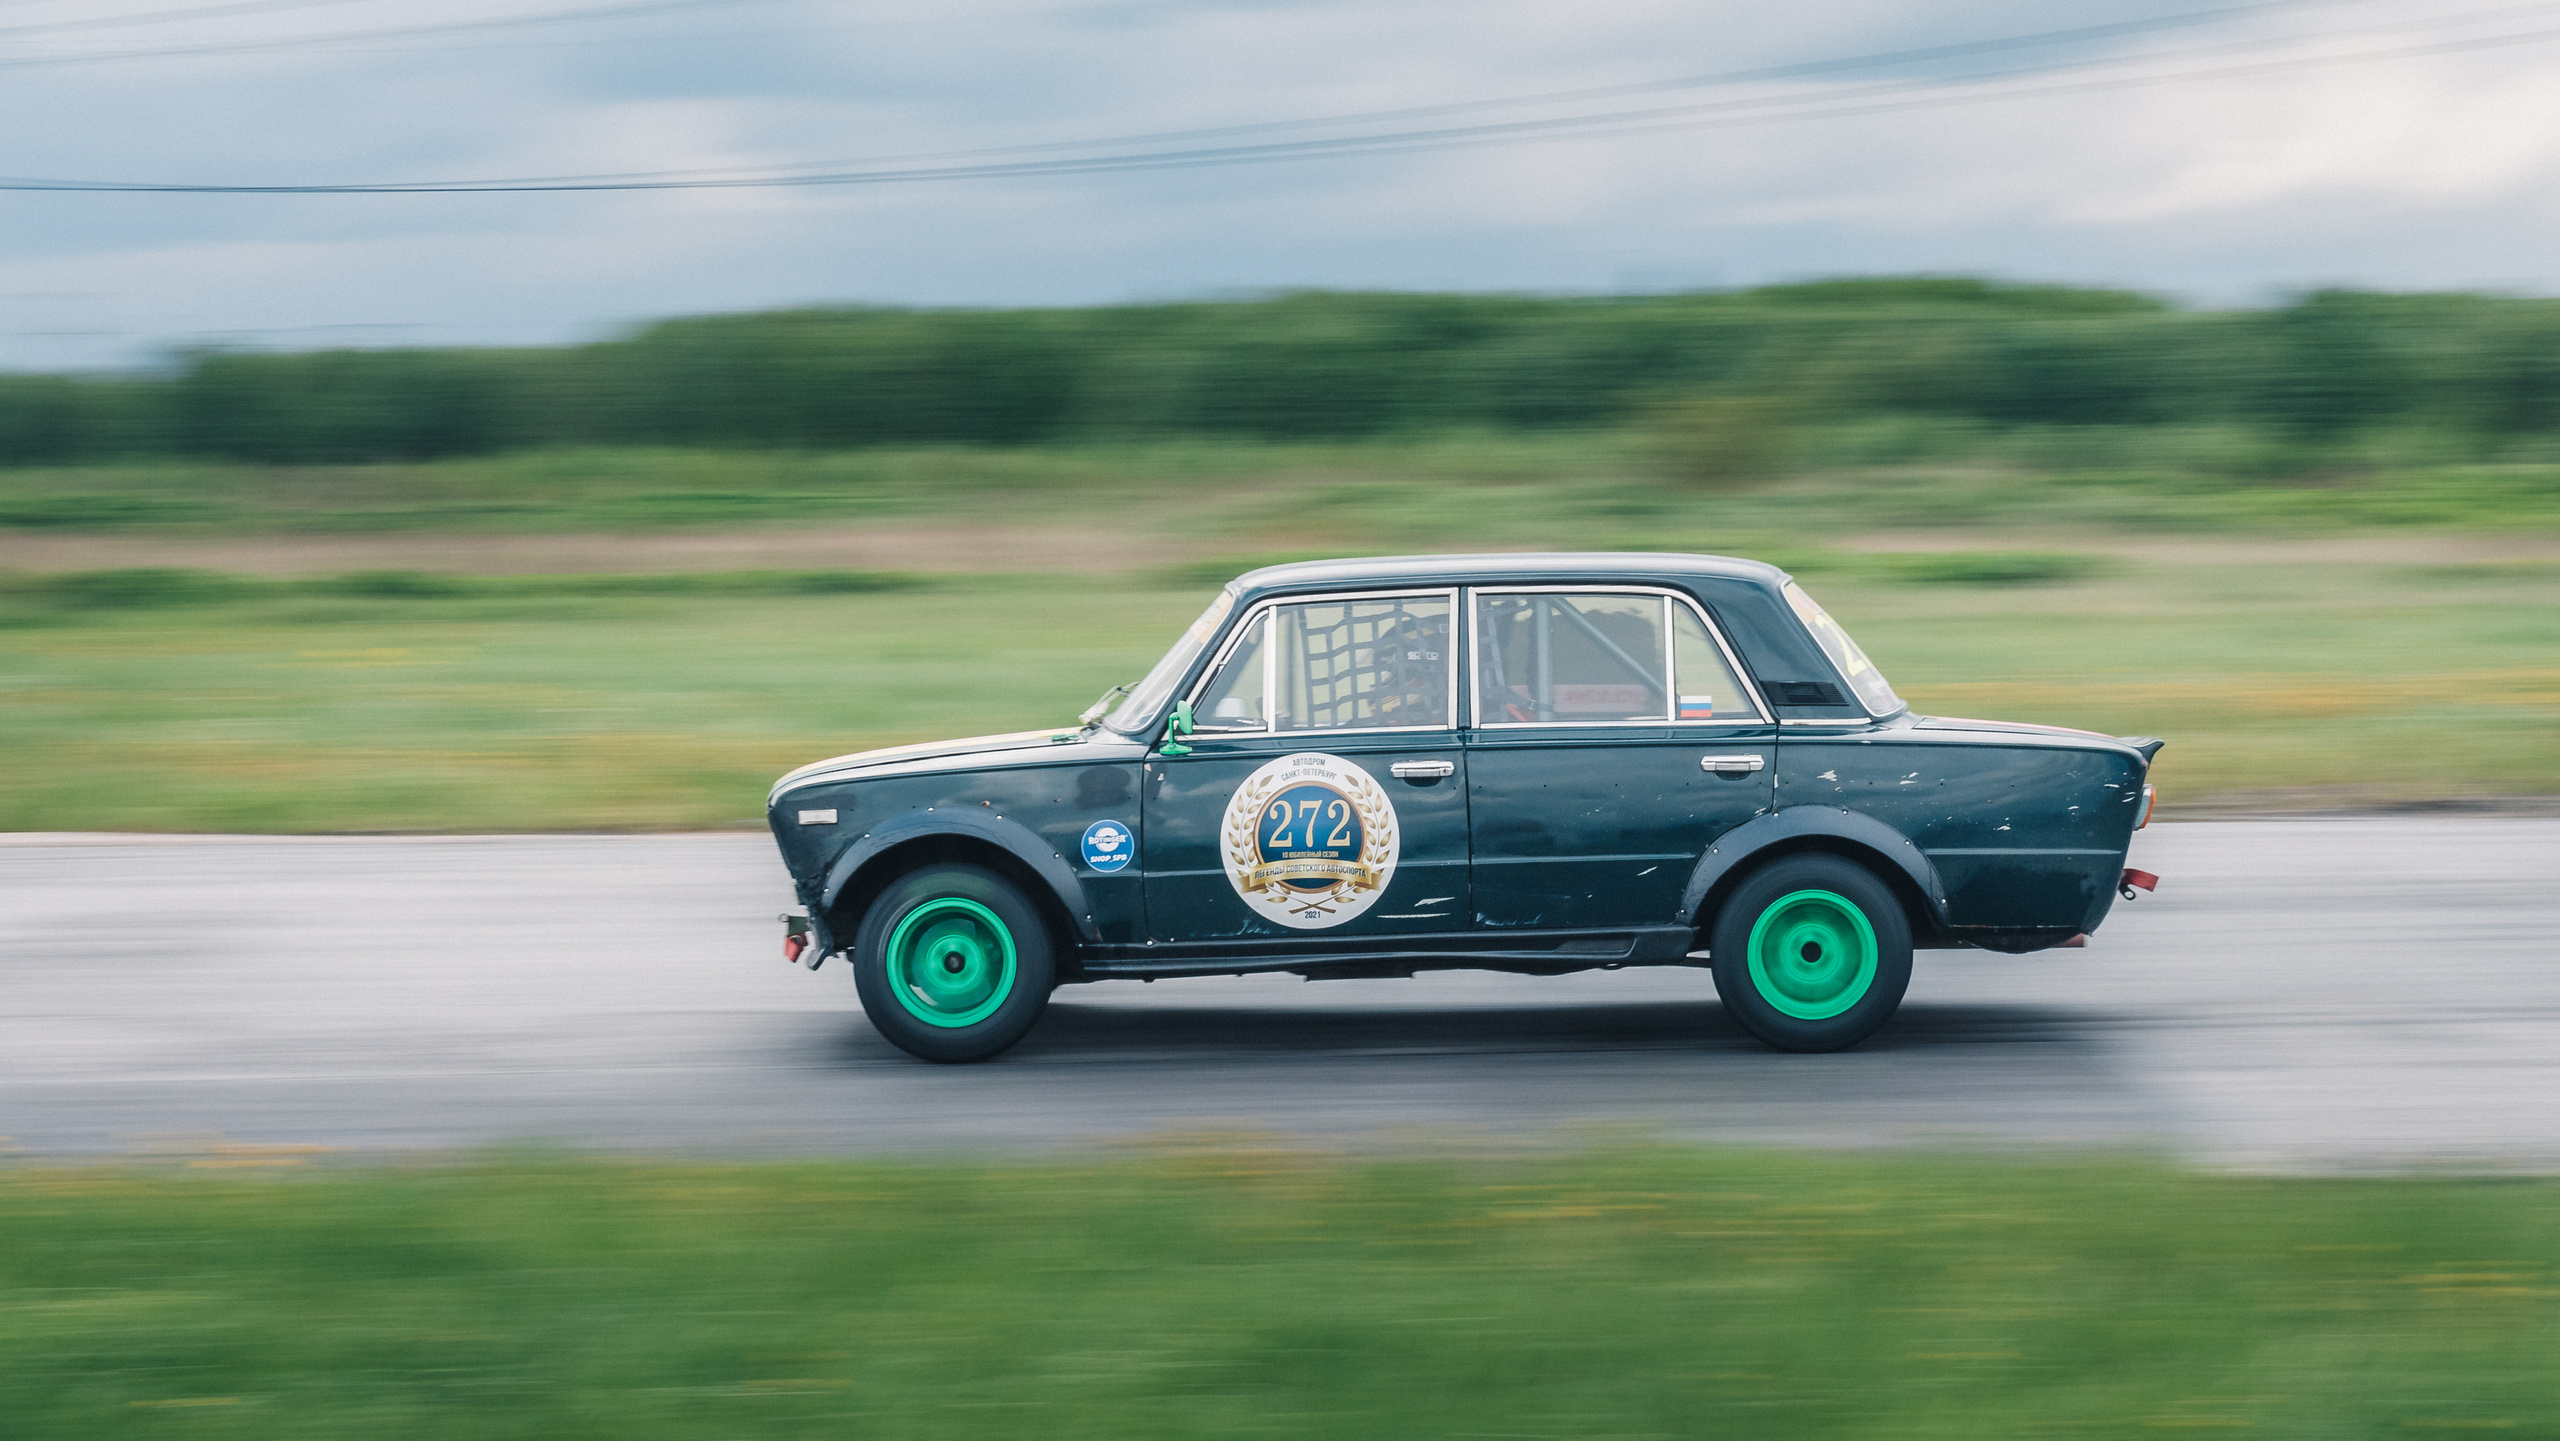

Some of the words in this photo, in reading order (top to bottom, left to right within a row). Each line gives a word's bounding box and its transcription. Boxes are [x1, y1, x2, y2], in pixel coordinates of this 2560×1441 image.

[1292, 758, 1326, 766] АВТОДРОМ
[1281, 769, 1337, 781] САНКТ-ПЕТЕРБУРГ
[1268, 799, 1351, 848] 272
[1289, 850, 1322, 858] ЮБИЛЕЙНЫЙ
[1255, 867, 1286, 879] ЛЕГЕНДЫ
[1286, 864, 1326, 874] СОВЕТСКОГО
[1326, 865, 1367, 878] АВТОСПОРТА
[1304, 911, 1321, 919] 2021
